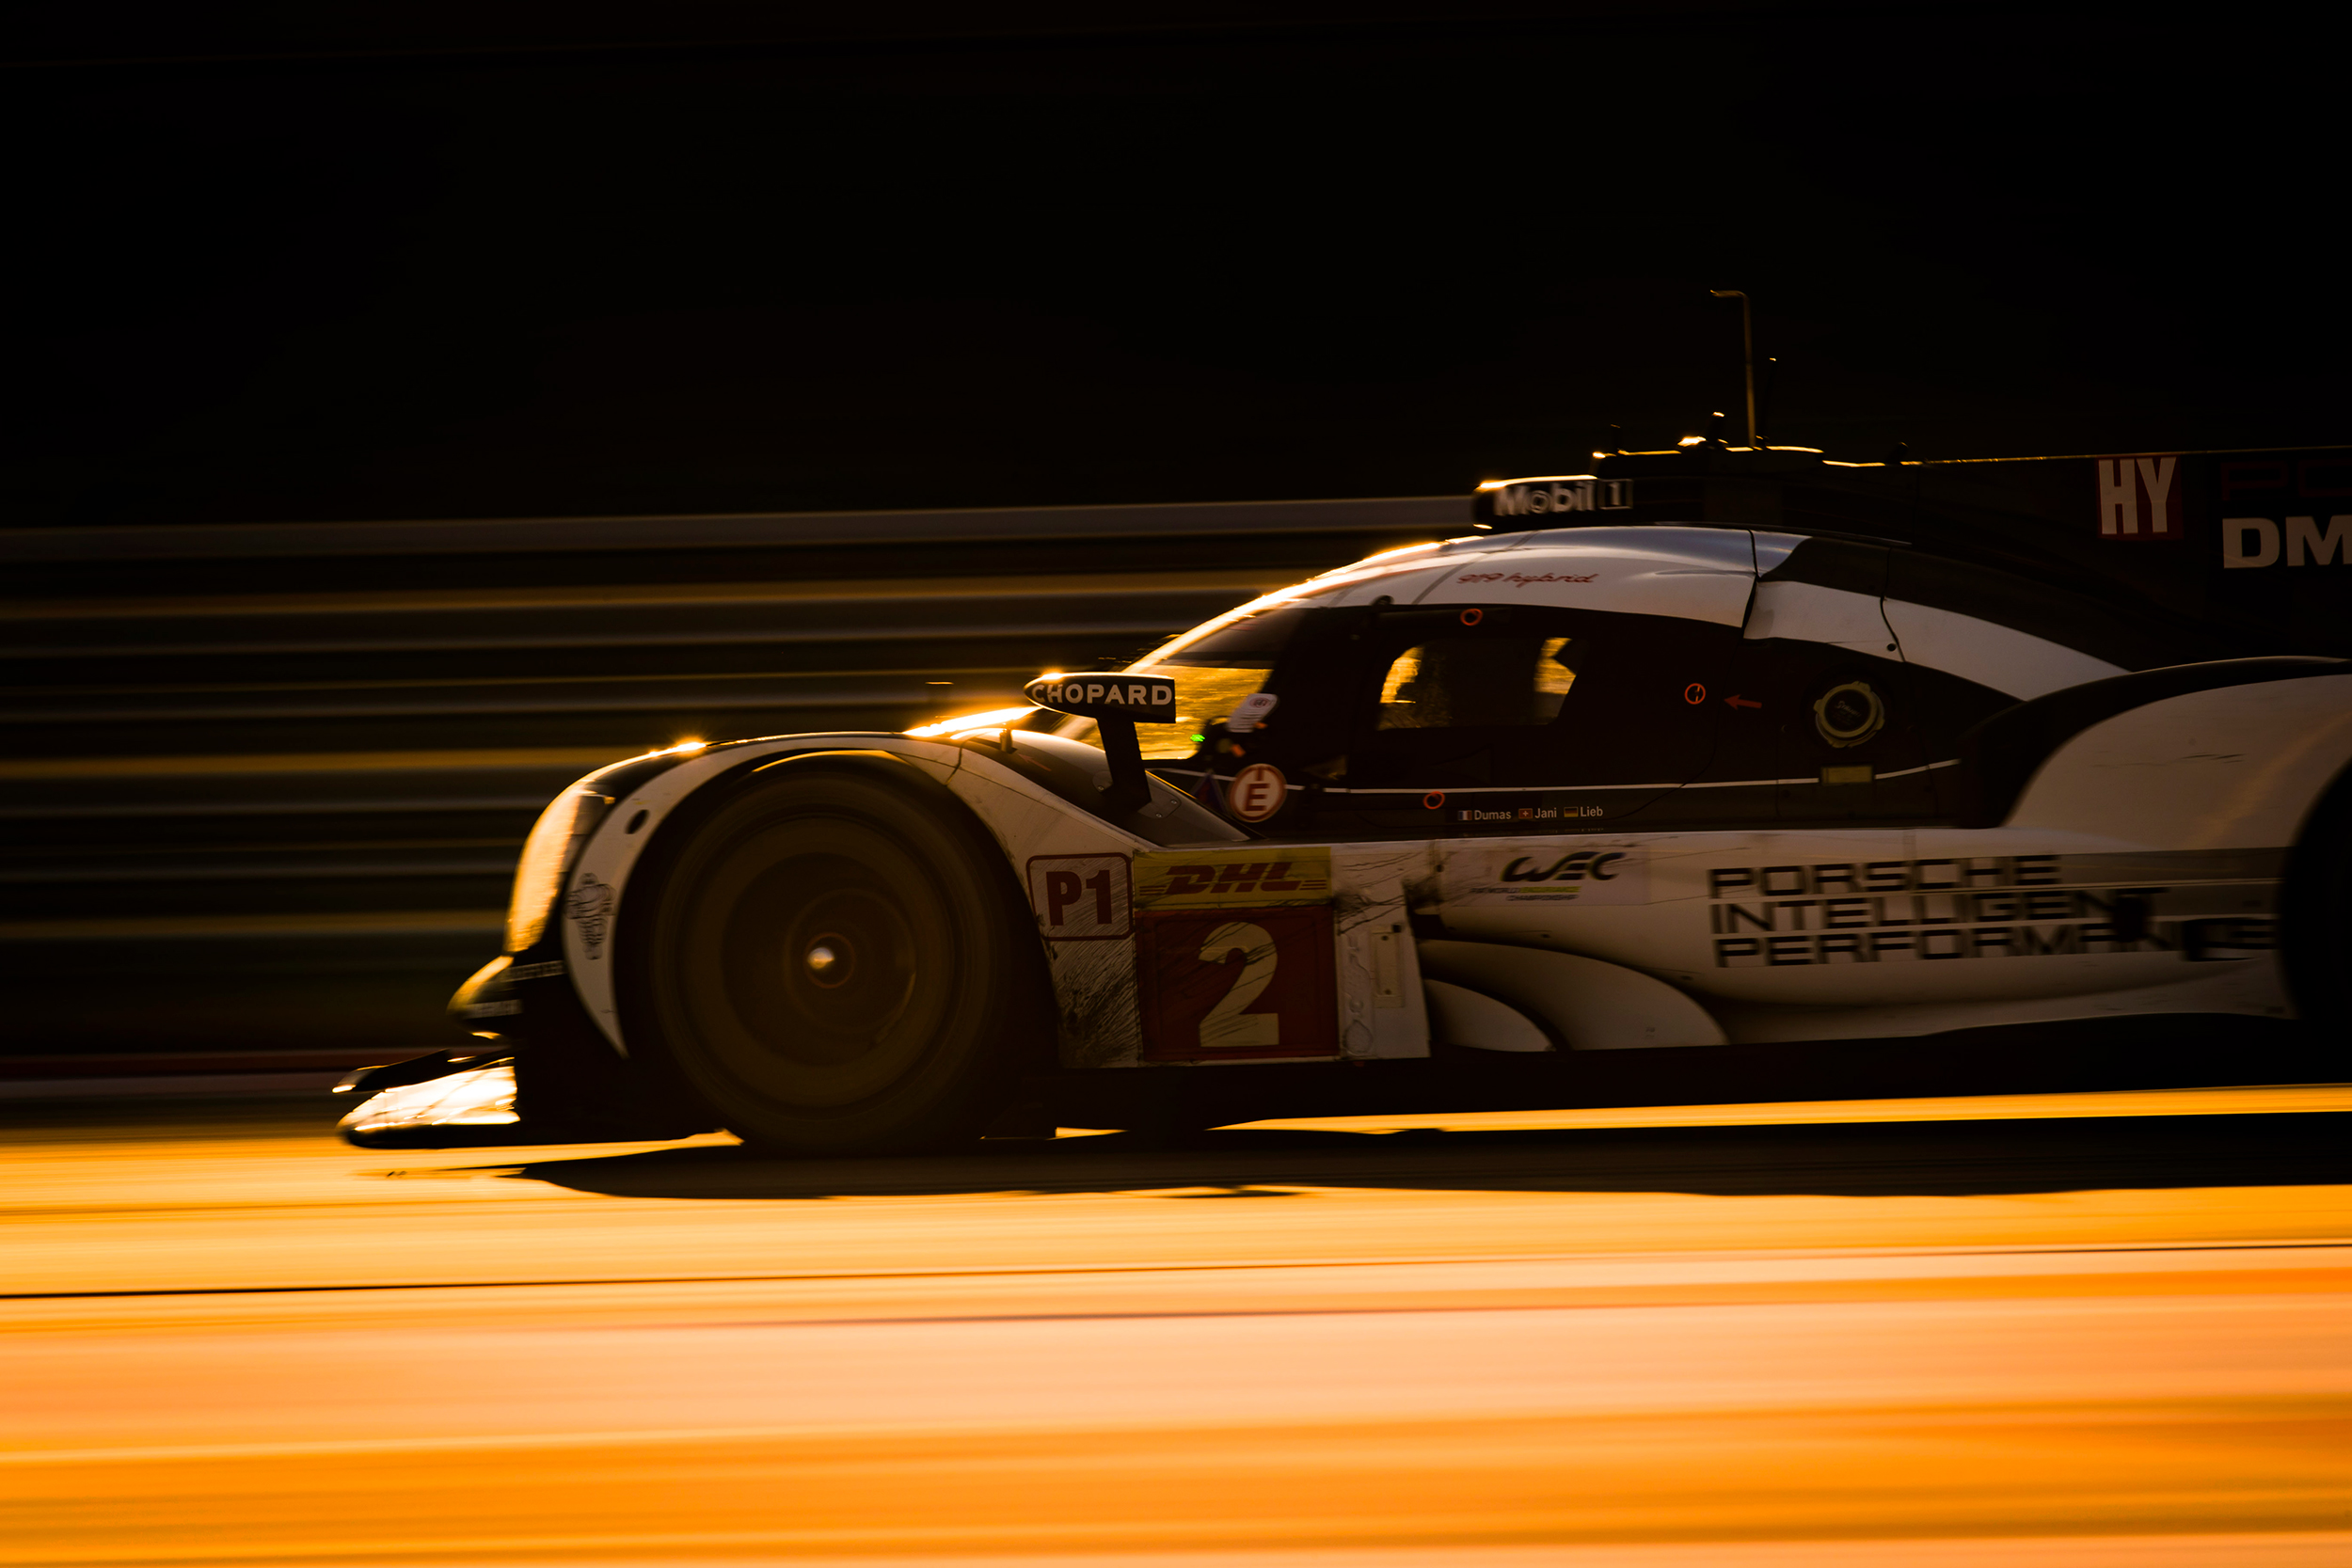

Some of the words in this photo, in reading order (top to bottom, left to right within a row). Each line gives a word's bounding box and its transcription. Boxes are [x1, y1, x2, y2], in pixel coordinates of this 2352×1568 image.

[1493, 481, 1596, 516] Mobil
[2099, 457, 2177, 534] HY
[2222, 514, 2352, 569] DM
[1503, 572, 1598, 588] hybrid
[1031, 683, 1172, 705] CHOPARD
[1244, 783, 1270, 811] E
[1473, 809, 1512, 821] Dumas
[1534, 807, 1557, 819] Jani
[1580, 806, 1603, 817] Lieb
[1165, 862, 1302, 895] DHL
[1500, 851, 1626, 882] WEC
[1708, 855, 2061, 898] PORSCHE
[1046, 869, 1113, 927] P1
[1709, 888, 2169, 934] INTELLIGENT
[1198, 921, 1279, 1048] 2
